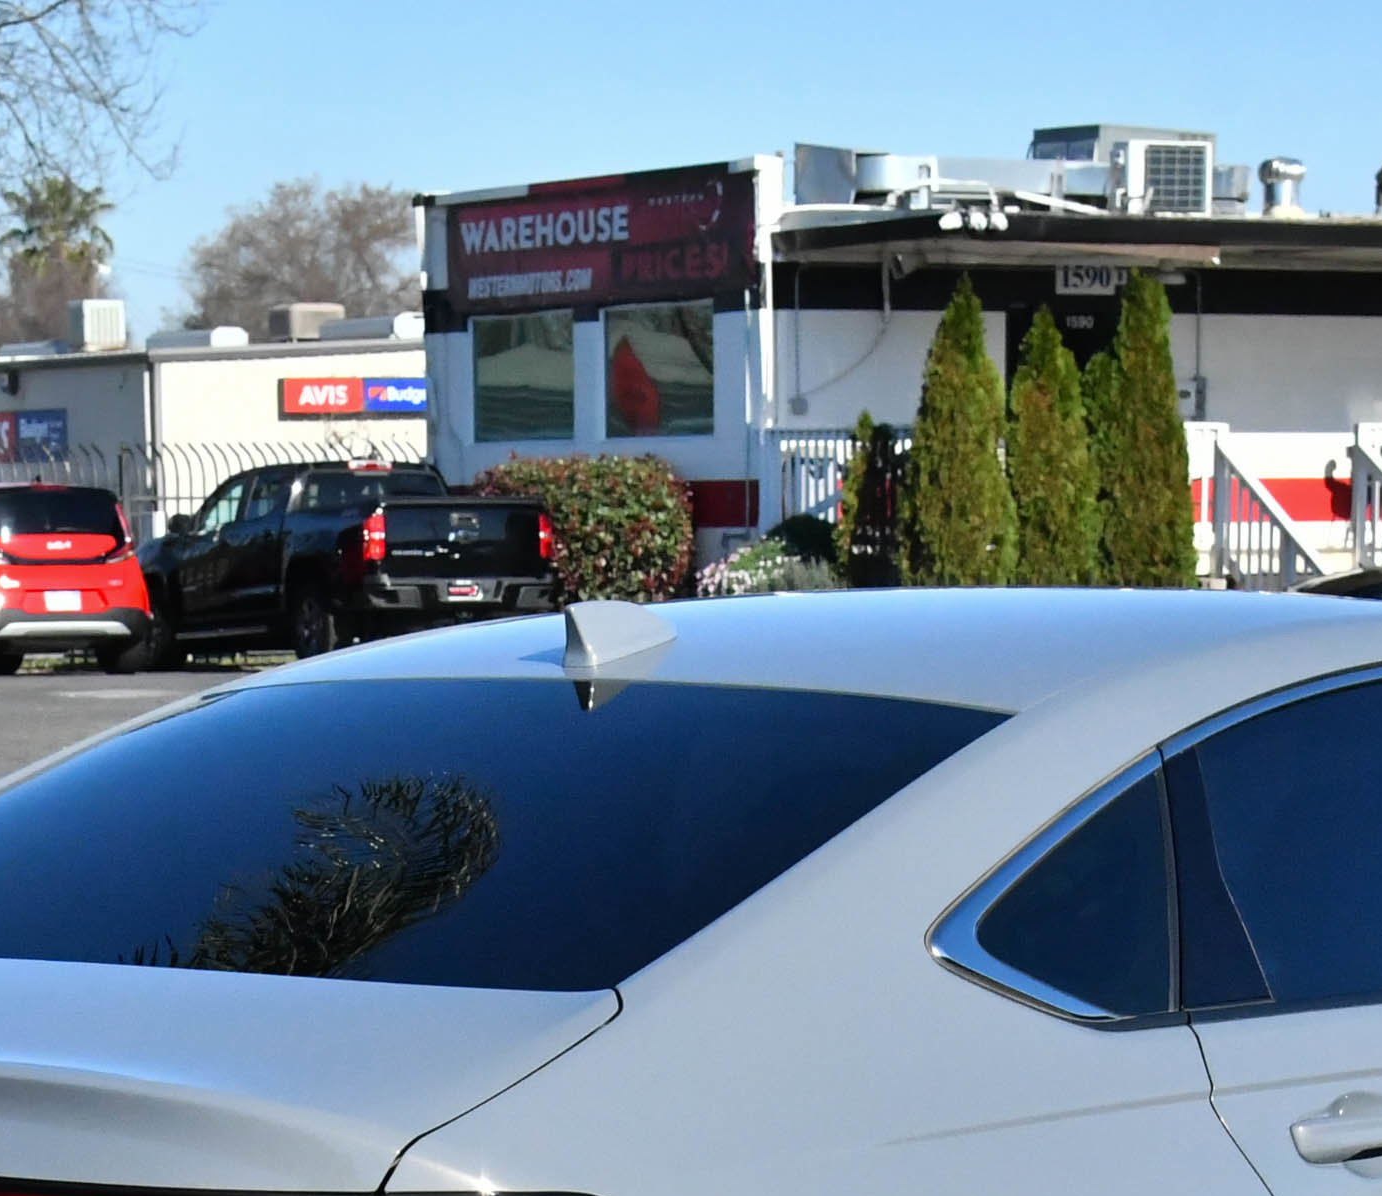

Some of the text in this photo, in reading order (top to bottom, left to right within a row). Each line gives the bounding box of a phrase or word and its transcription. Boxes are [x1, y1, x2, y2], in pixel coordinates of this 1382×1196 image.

[460, 204, 630, 256] WAREHOUSE
[1063, 264, 1112, 289] 1590
[297, 384, 349, 406] AVIS
